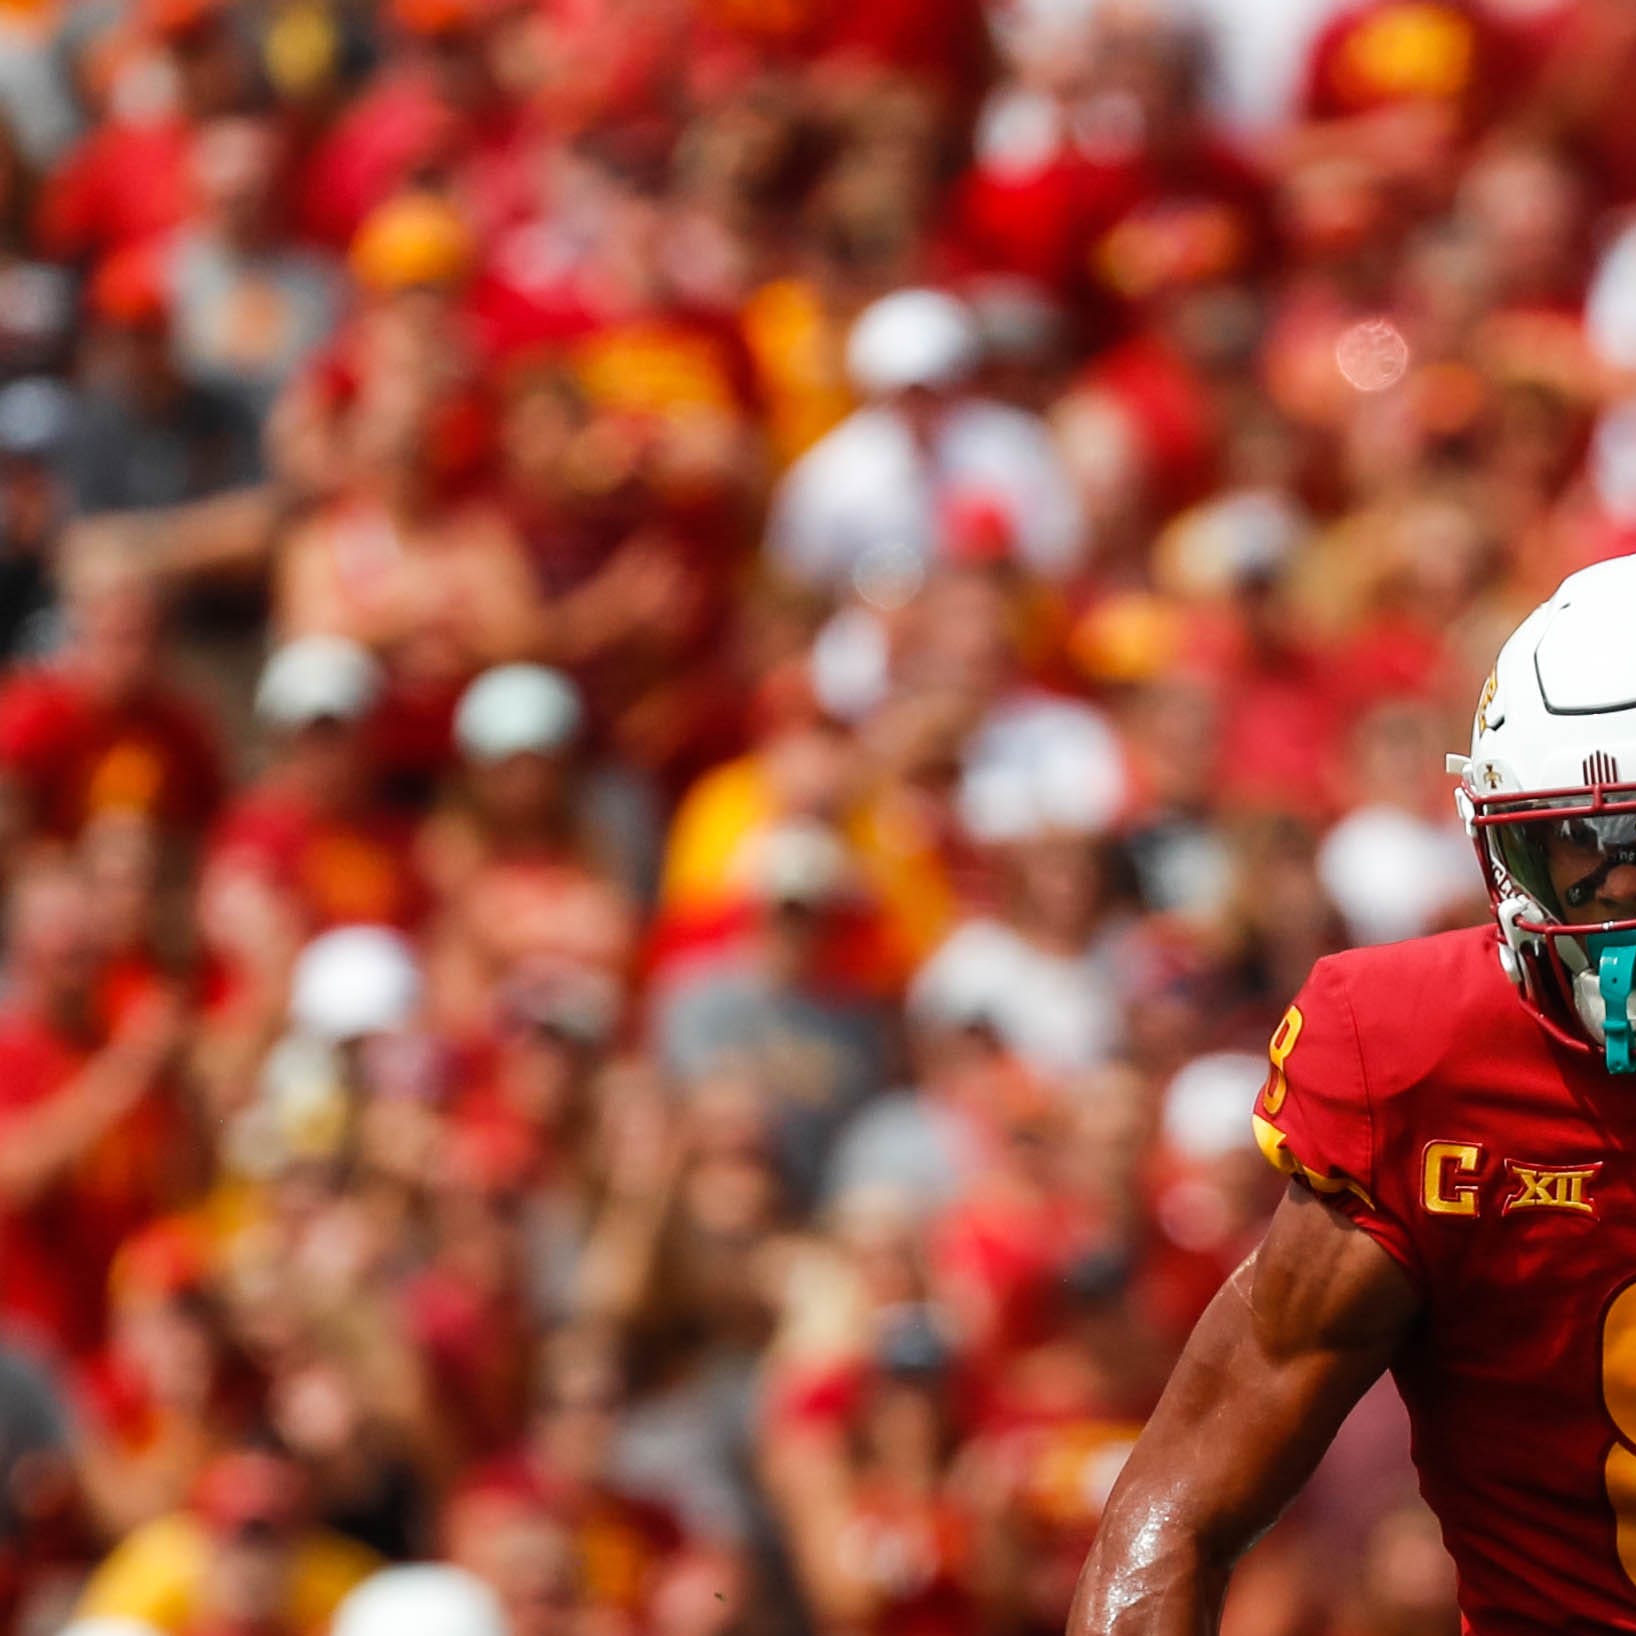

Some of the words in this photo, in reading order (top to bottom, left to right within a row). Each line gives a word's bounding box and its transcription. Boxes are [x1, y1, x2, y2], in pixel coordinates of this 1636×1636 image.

[1263, 1003, 1304, 1115] 8
[1422, 1141, 1480, 1216] C
[1507, 1164, 1597, 1214] XII
